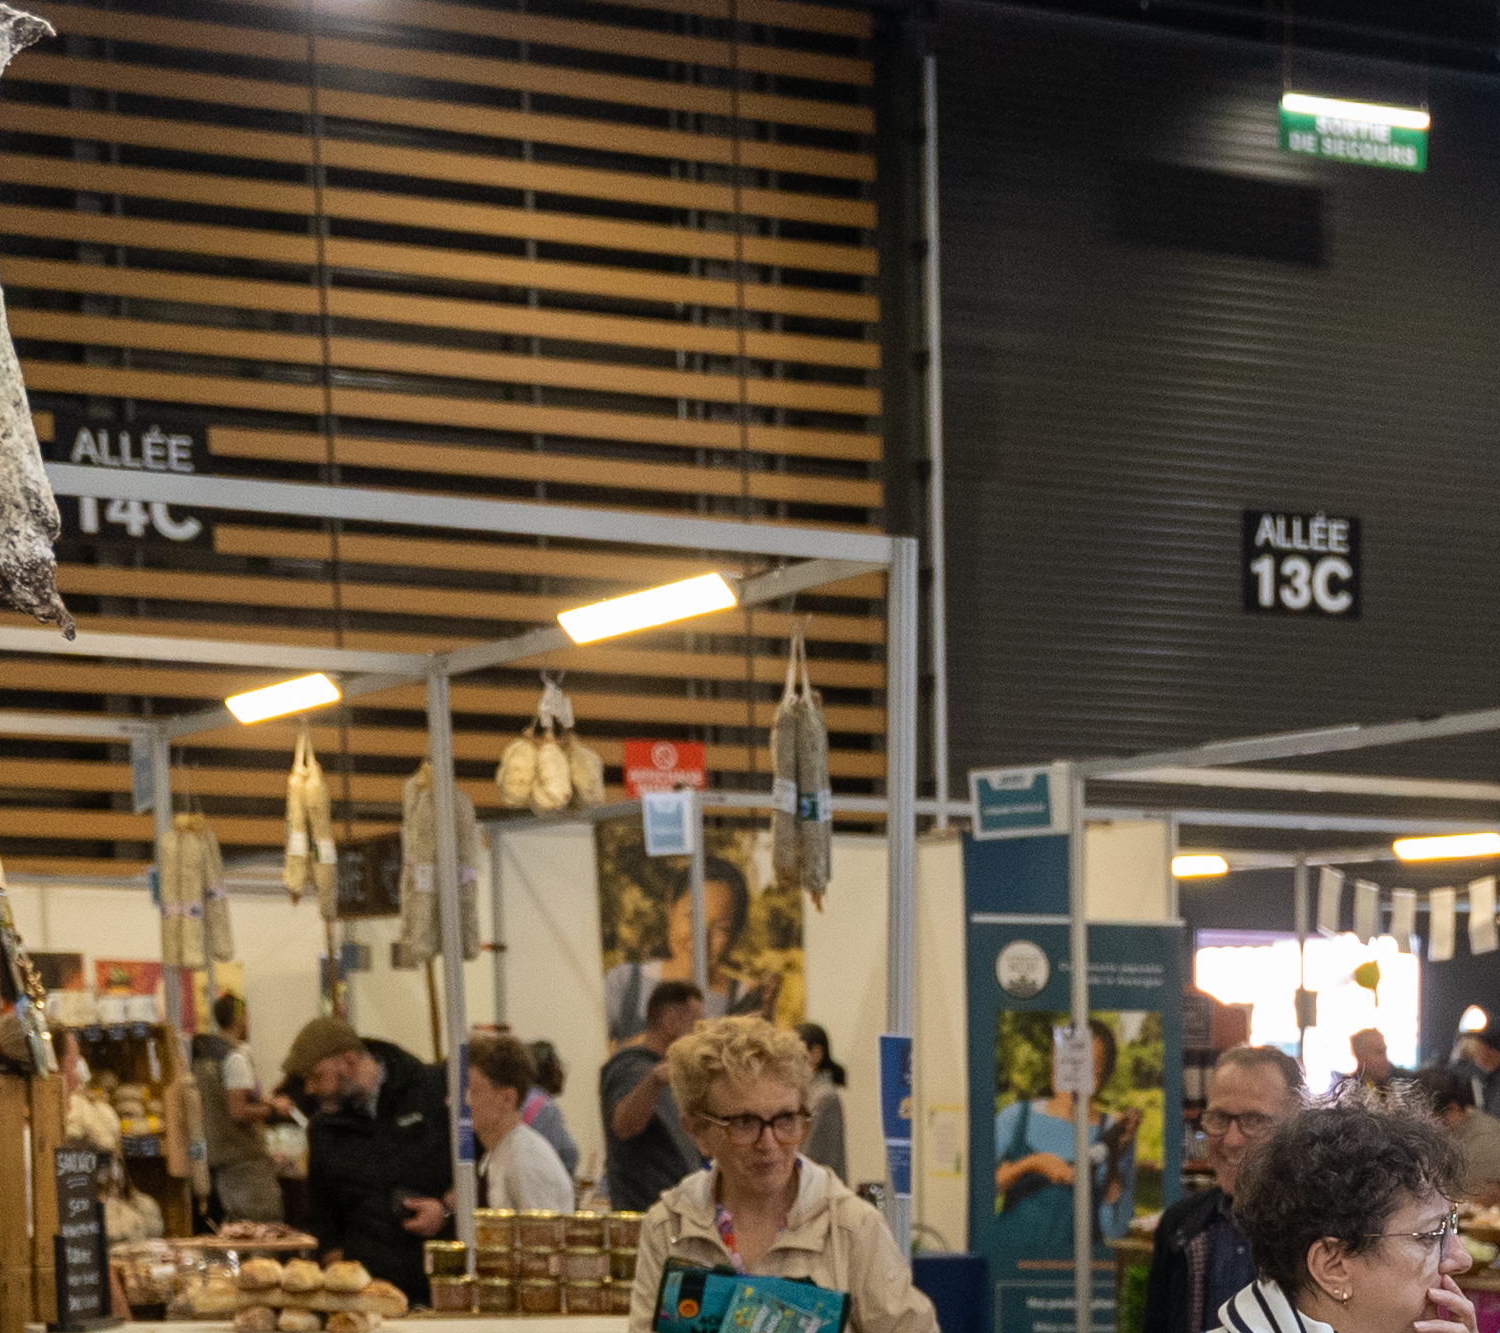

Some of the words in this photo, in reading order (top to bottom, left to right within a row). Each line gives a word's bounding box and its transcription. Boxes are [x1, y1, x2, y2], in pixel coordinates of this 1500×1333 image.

[1289, 130, 1319, 153] DE
[1321, 136, 1417, 167] SECOURS
[70, 425, 195, 472] ALLÉE
[1254, 510, 1350, 553] ALLÉE
[1250, 553, 1353, 613] 13C
